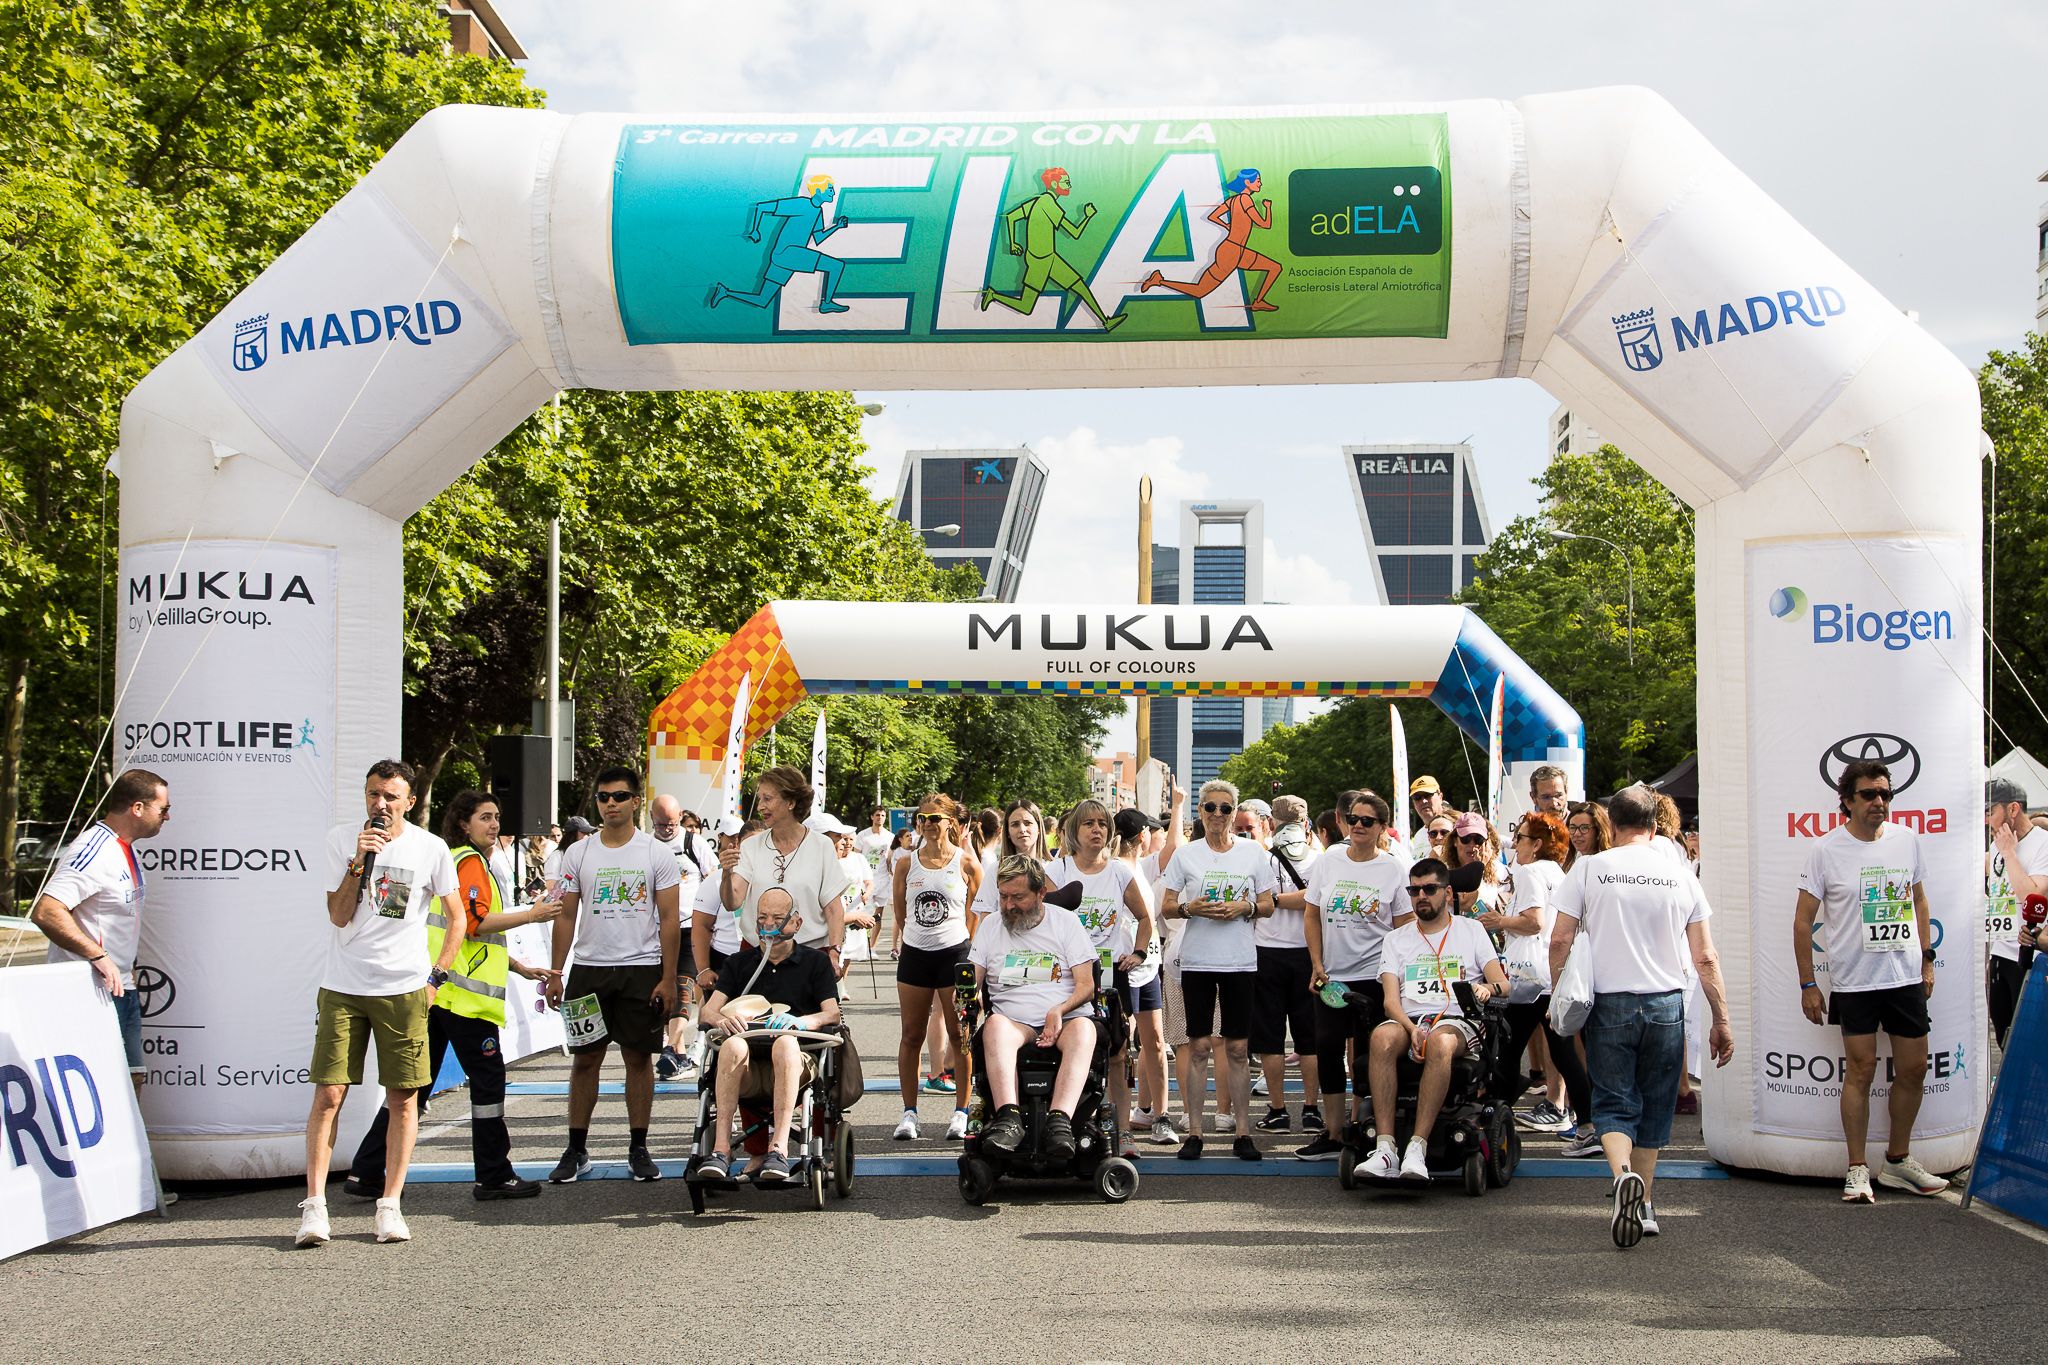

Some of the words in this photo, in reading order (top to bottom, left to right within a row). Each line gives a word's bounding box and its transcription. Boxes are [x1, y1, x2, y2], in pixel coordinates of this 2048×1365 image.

[679, 129, 798, 144] Carrera
[811, 125, 1018, 148] MADRID
[1032, 124, 1142, 146] CON
[1153, 122, 1217, 144] LA
[772, 150, 1256, 335] ELA
[1288, 267, 1346, 277] Asociación
[1349, 266, 1397, 278] Española
[1399, 265, 1413, 275] de
[1288, 282, 1340, 293] Esclerosis
[1343, 282, 1379, 292] Lateral
[1381, 281, 1442, 291] Amiotrófica
[280, 300, 462, 355] MADRID
[1671, 286, 1847, 353] MADRID
[129, 571, 316, 606] MUKUA
[129, 614, 144, 633] by
[968, 613, 1274, 651] MUKUA
[1812, 603, 1952, 651] Biogen
[1047, 661, 1083, 673] FULL
[1090, 661, 1111, 673] OF
[1117, 661, 1196, 674] COLOURS
[124, 721, 293, 751] SPORTLIFE
[162, 750, 233, 763] COMUNICACIÓN
[235, 753, 242, 763] Y
[245, 753, 292, 764] EVENTOS
[1869, 923, 1911, 941] 1278
[217, 1064, 311, 1087] Service
[1767, 1082, 1822, 1098] MOVILIDAD,
[0, 1054, 104, 1178] RID
